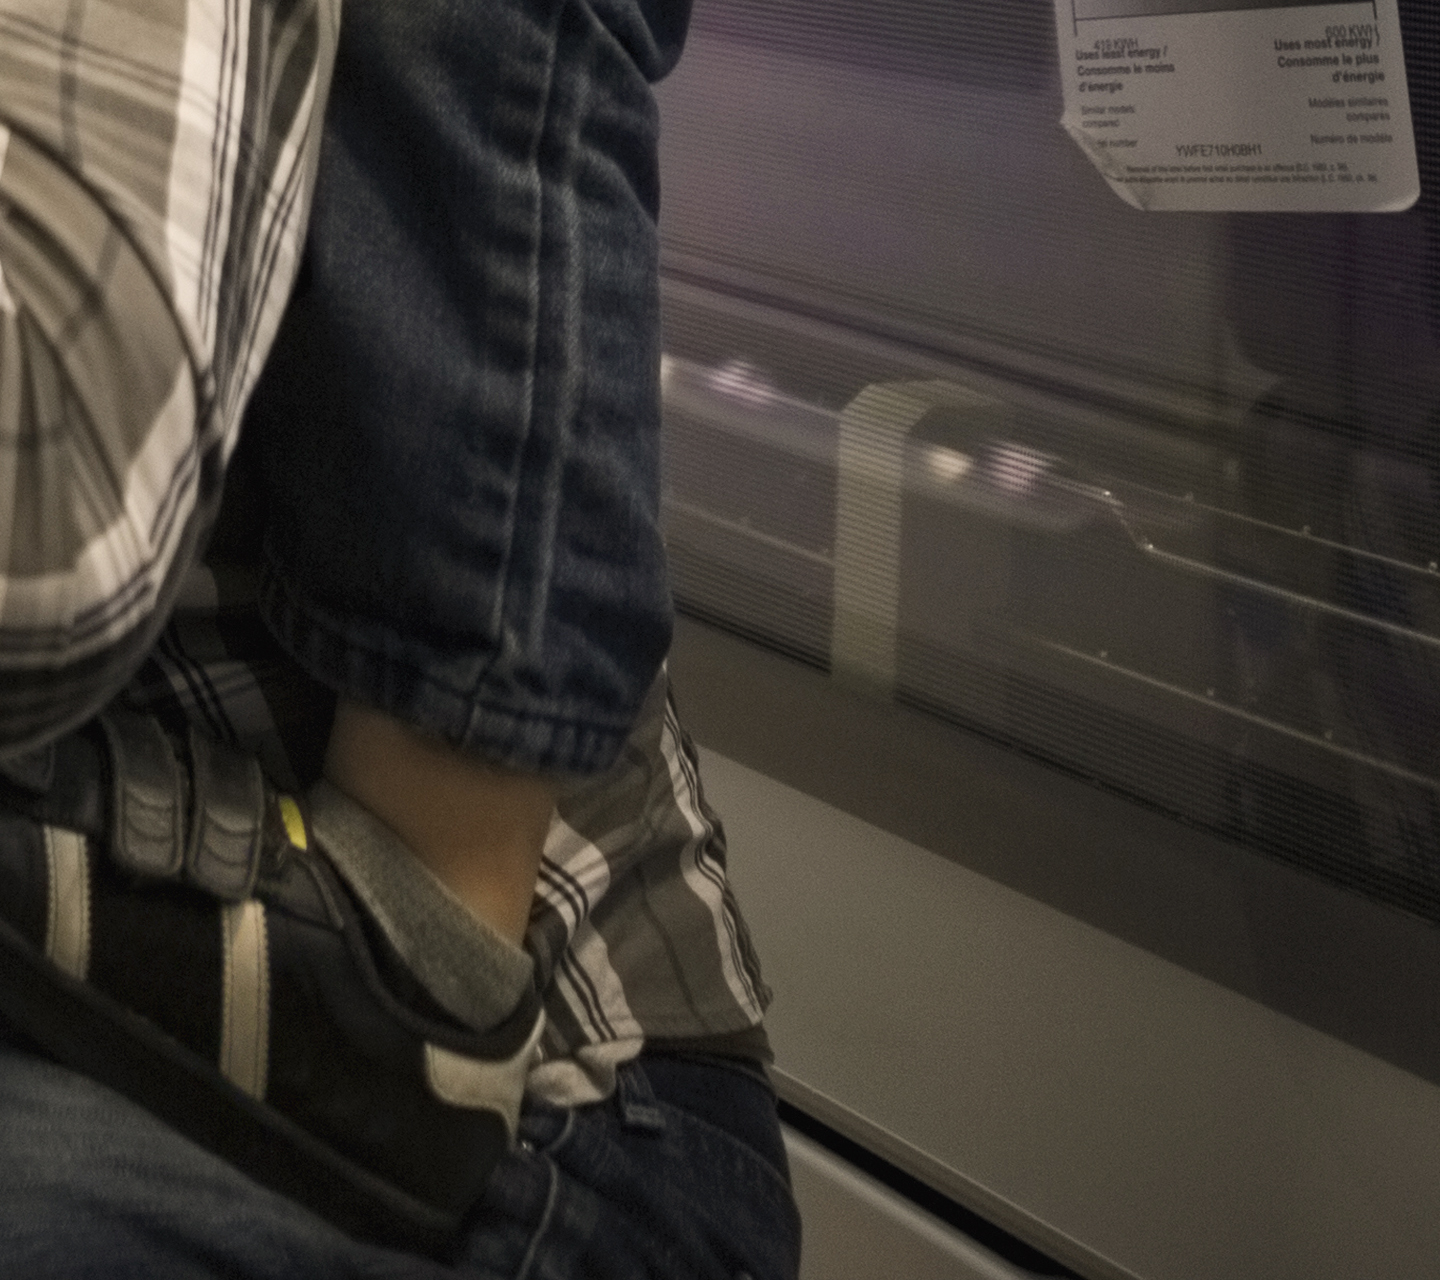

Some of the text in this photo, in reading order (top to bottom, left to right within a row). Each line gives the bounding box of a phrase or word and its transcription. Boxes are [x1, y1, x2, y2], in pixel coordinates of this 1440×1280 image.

[1325, 24, 1347, 39] 600
[1274, 39, 1301, 51] Uses
[1304, 37, 1332, 50] most
[1334, 38, 1372, 50] energy
[1075, 49, 1099, 60] Uses
[1101, 47, 1125, 59] least
[1127, 48, 1161, 60] energy
[1277, 52, 1379, 68] Consomme le plus
[1077, 65, 1131, 76] Consomme
